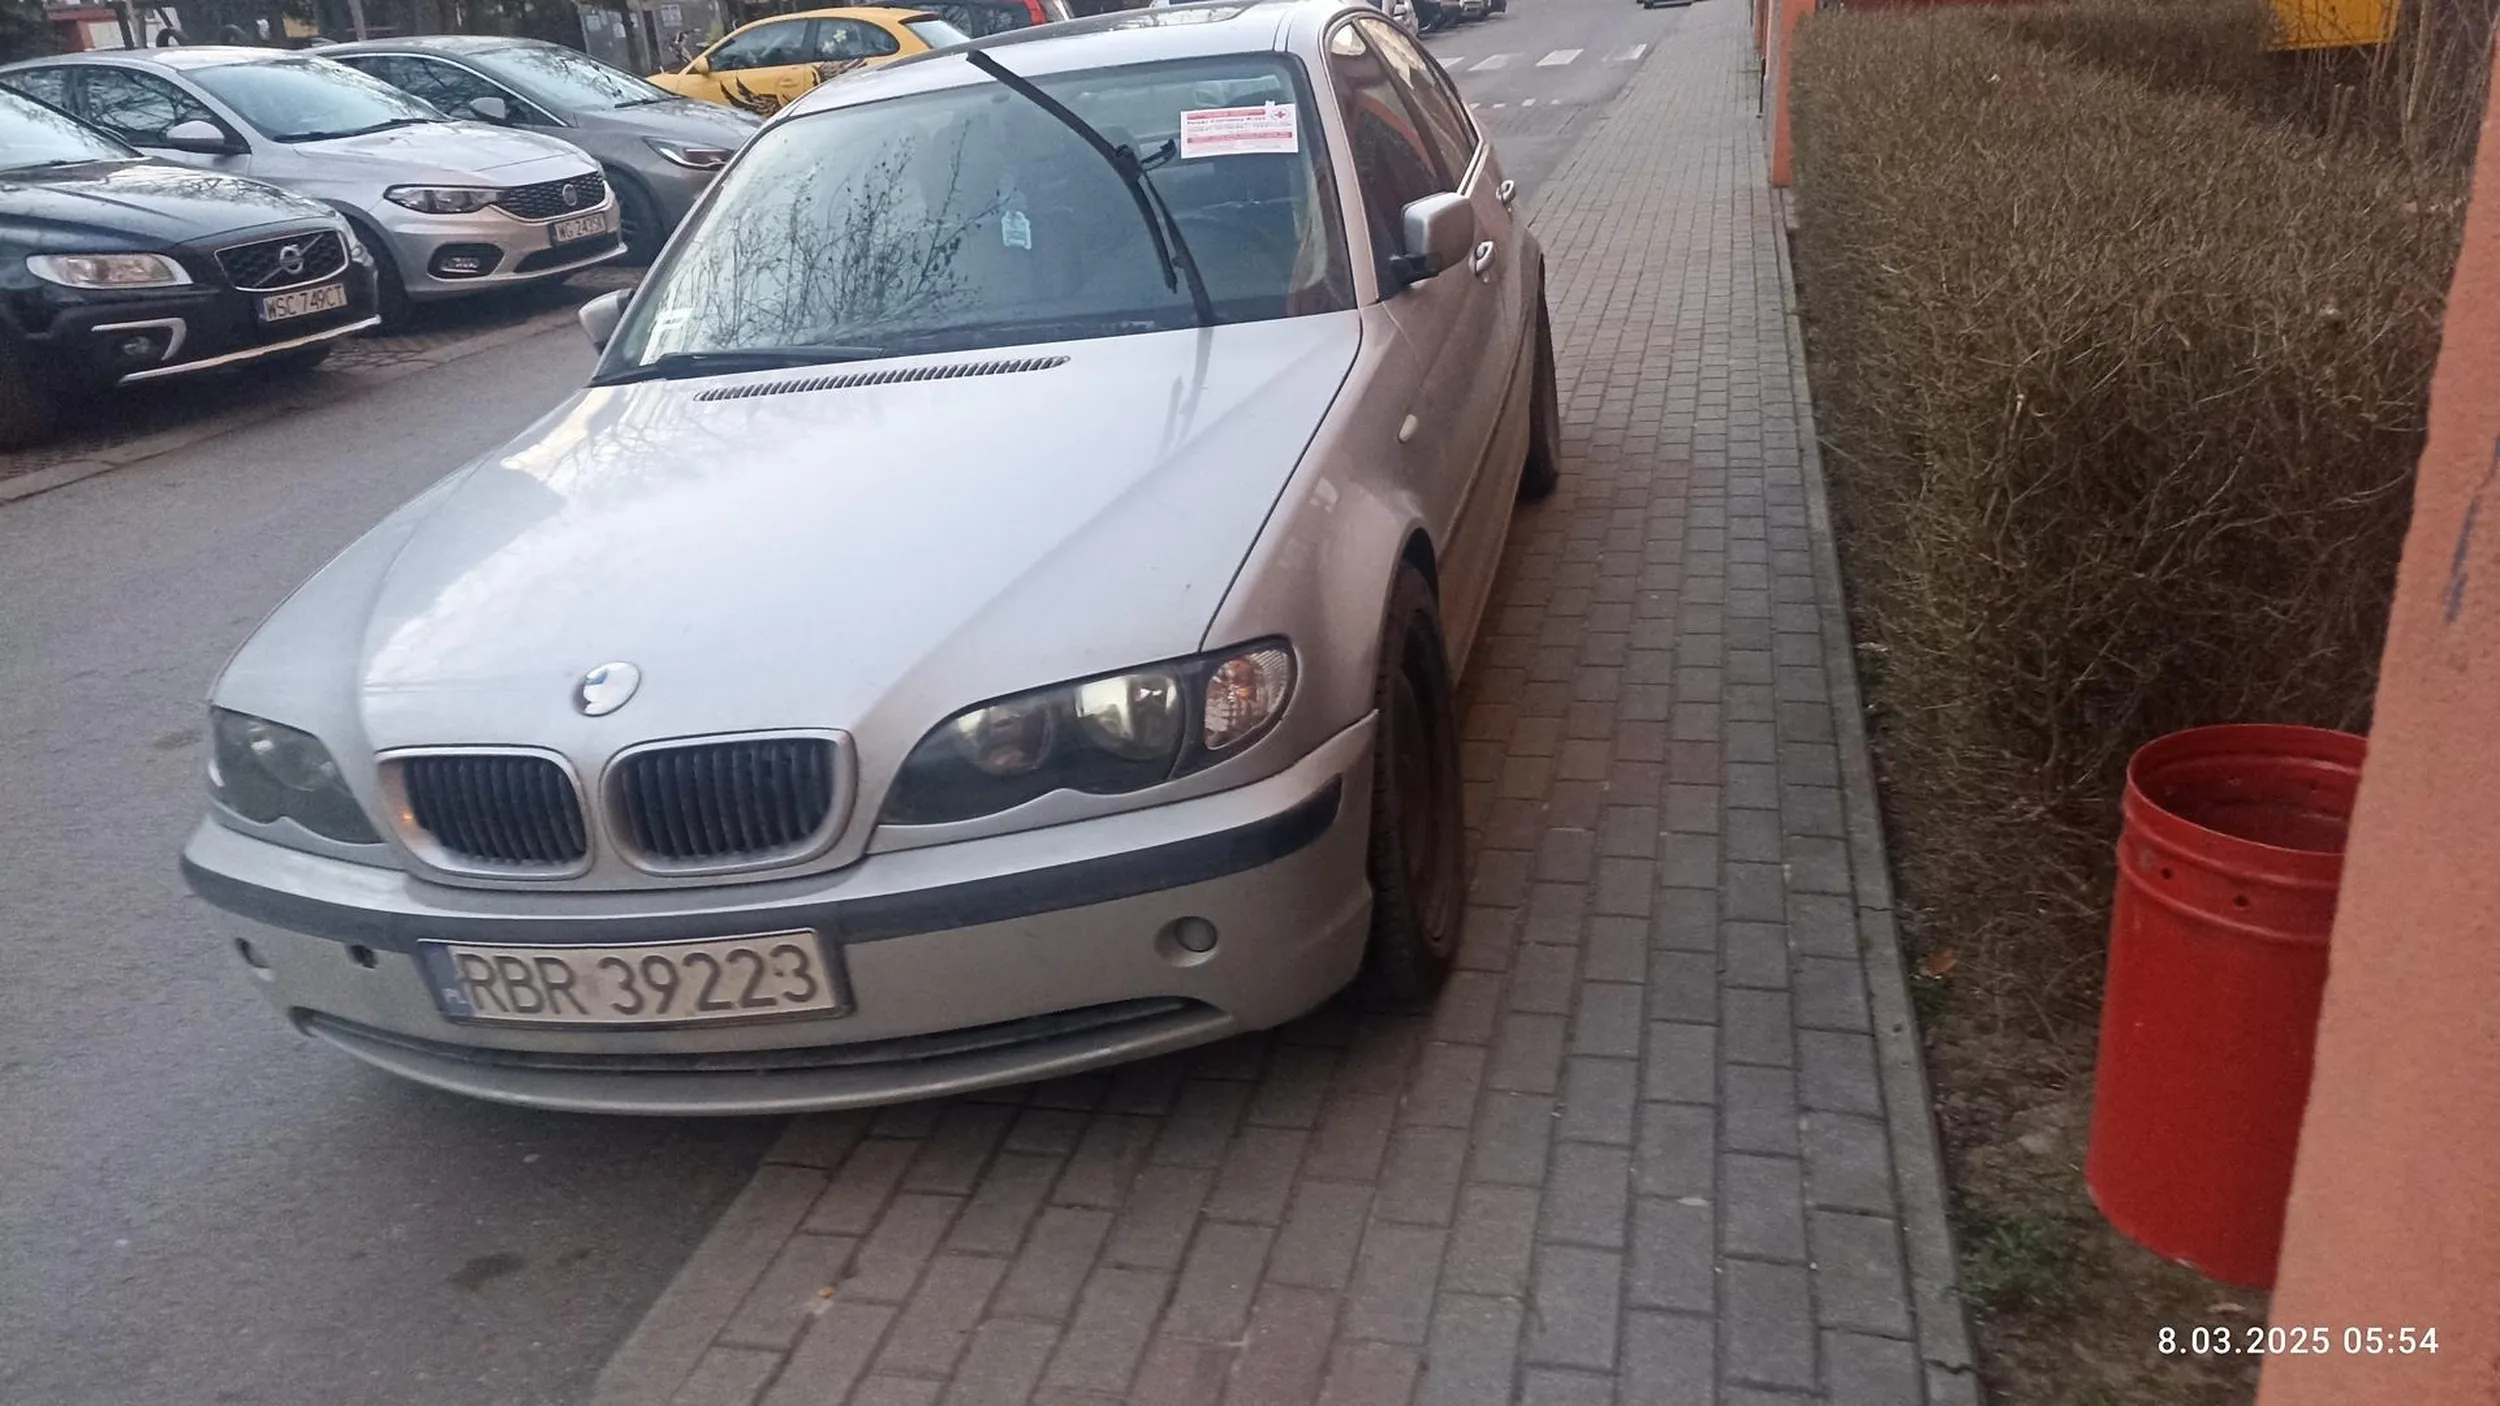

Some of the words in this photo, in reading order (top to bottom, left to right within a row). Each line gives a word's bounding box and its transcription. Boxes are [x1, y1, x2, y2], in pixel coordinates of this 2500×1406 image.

[266, 295, 297, 319] WSC
[300, 285, 343, 312] 749CT
[456, 953, 590, 1015] RBR
[597, 943, 819, 1015] 39223
